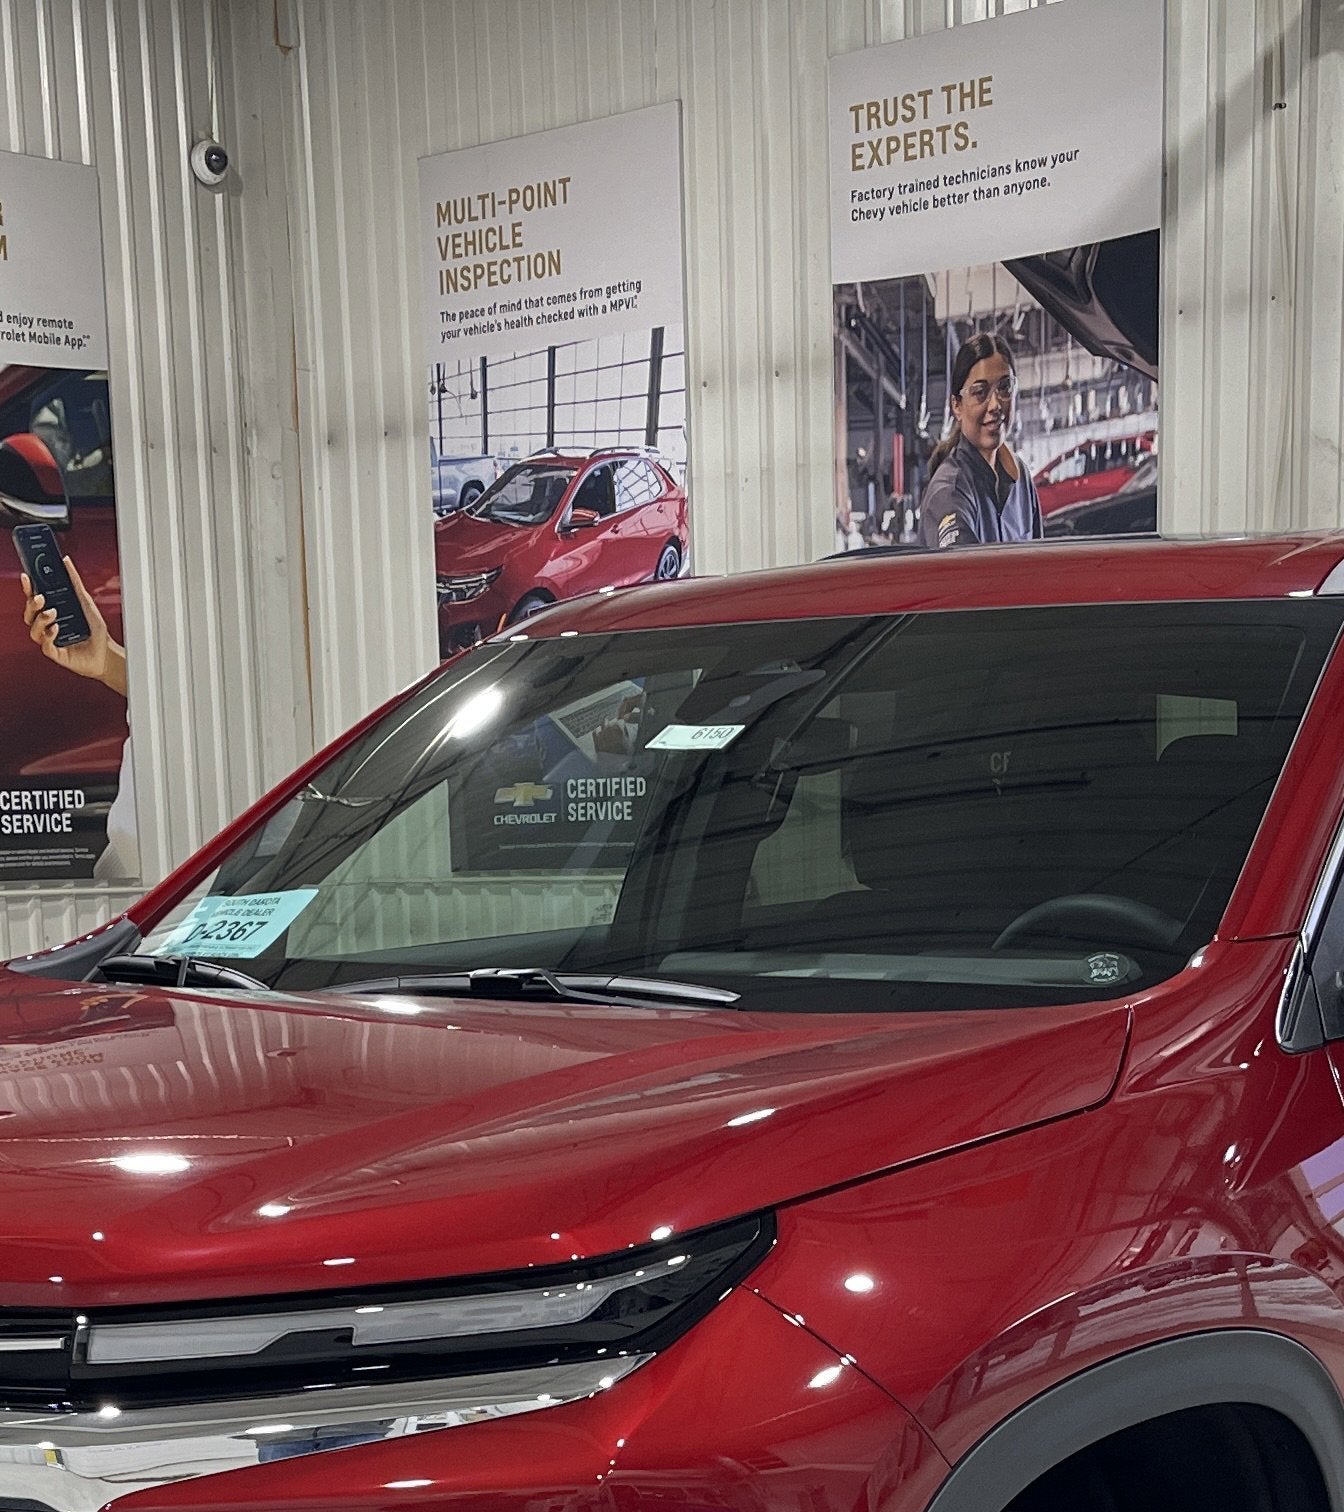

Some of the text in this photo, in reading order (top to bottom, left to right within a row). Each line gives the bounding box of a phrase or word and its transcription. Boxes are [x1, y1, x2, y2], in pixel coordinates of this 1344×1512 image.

[849, 75, 994, 134] TRUST THE
[850, 120, 978, 172] EXPERTS.
[850, 148, 1080, 203] Factory trained technicians know your
[436, 176, 571, 228] MULTI-POINT
[851, 176, 1051, 222] Chevy vehicle better than anyone.
[437, 221, 524, 261] VEHICLE
[439, 248, 562, 296] INSPECTION
[439, 279, 642, 323] The peace of mind that comes from getting
[6, 313, 34, 329] enjoy
[36, 318, 74, 330] remote
[28, 331, 62, 346] Mobile
[440, 328, 462, 344] your
[463, 319, 502, 337] vehicle's
[504, 314, 534, 331] health
[535, 307, 575, 325] checked
[577, 303, 599, 319] with
[601, 303, 607, 314] a
[0, 789, 86, 811] CERTIFIED
[566, 776, 647, 799] CERTIFIED
[0, 813, 73, 835] SERVICE
[493, 813, 557, 825] CHEVROLET
[567, 801, 633, 822] SERVICE
